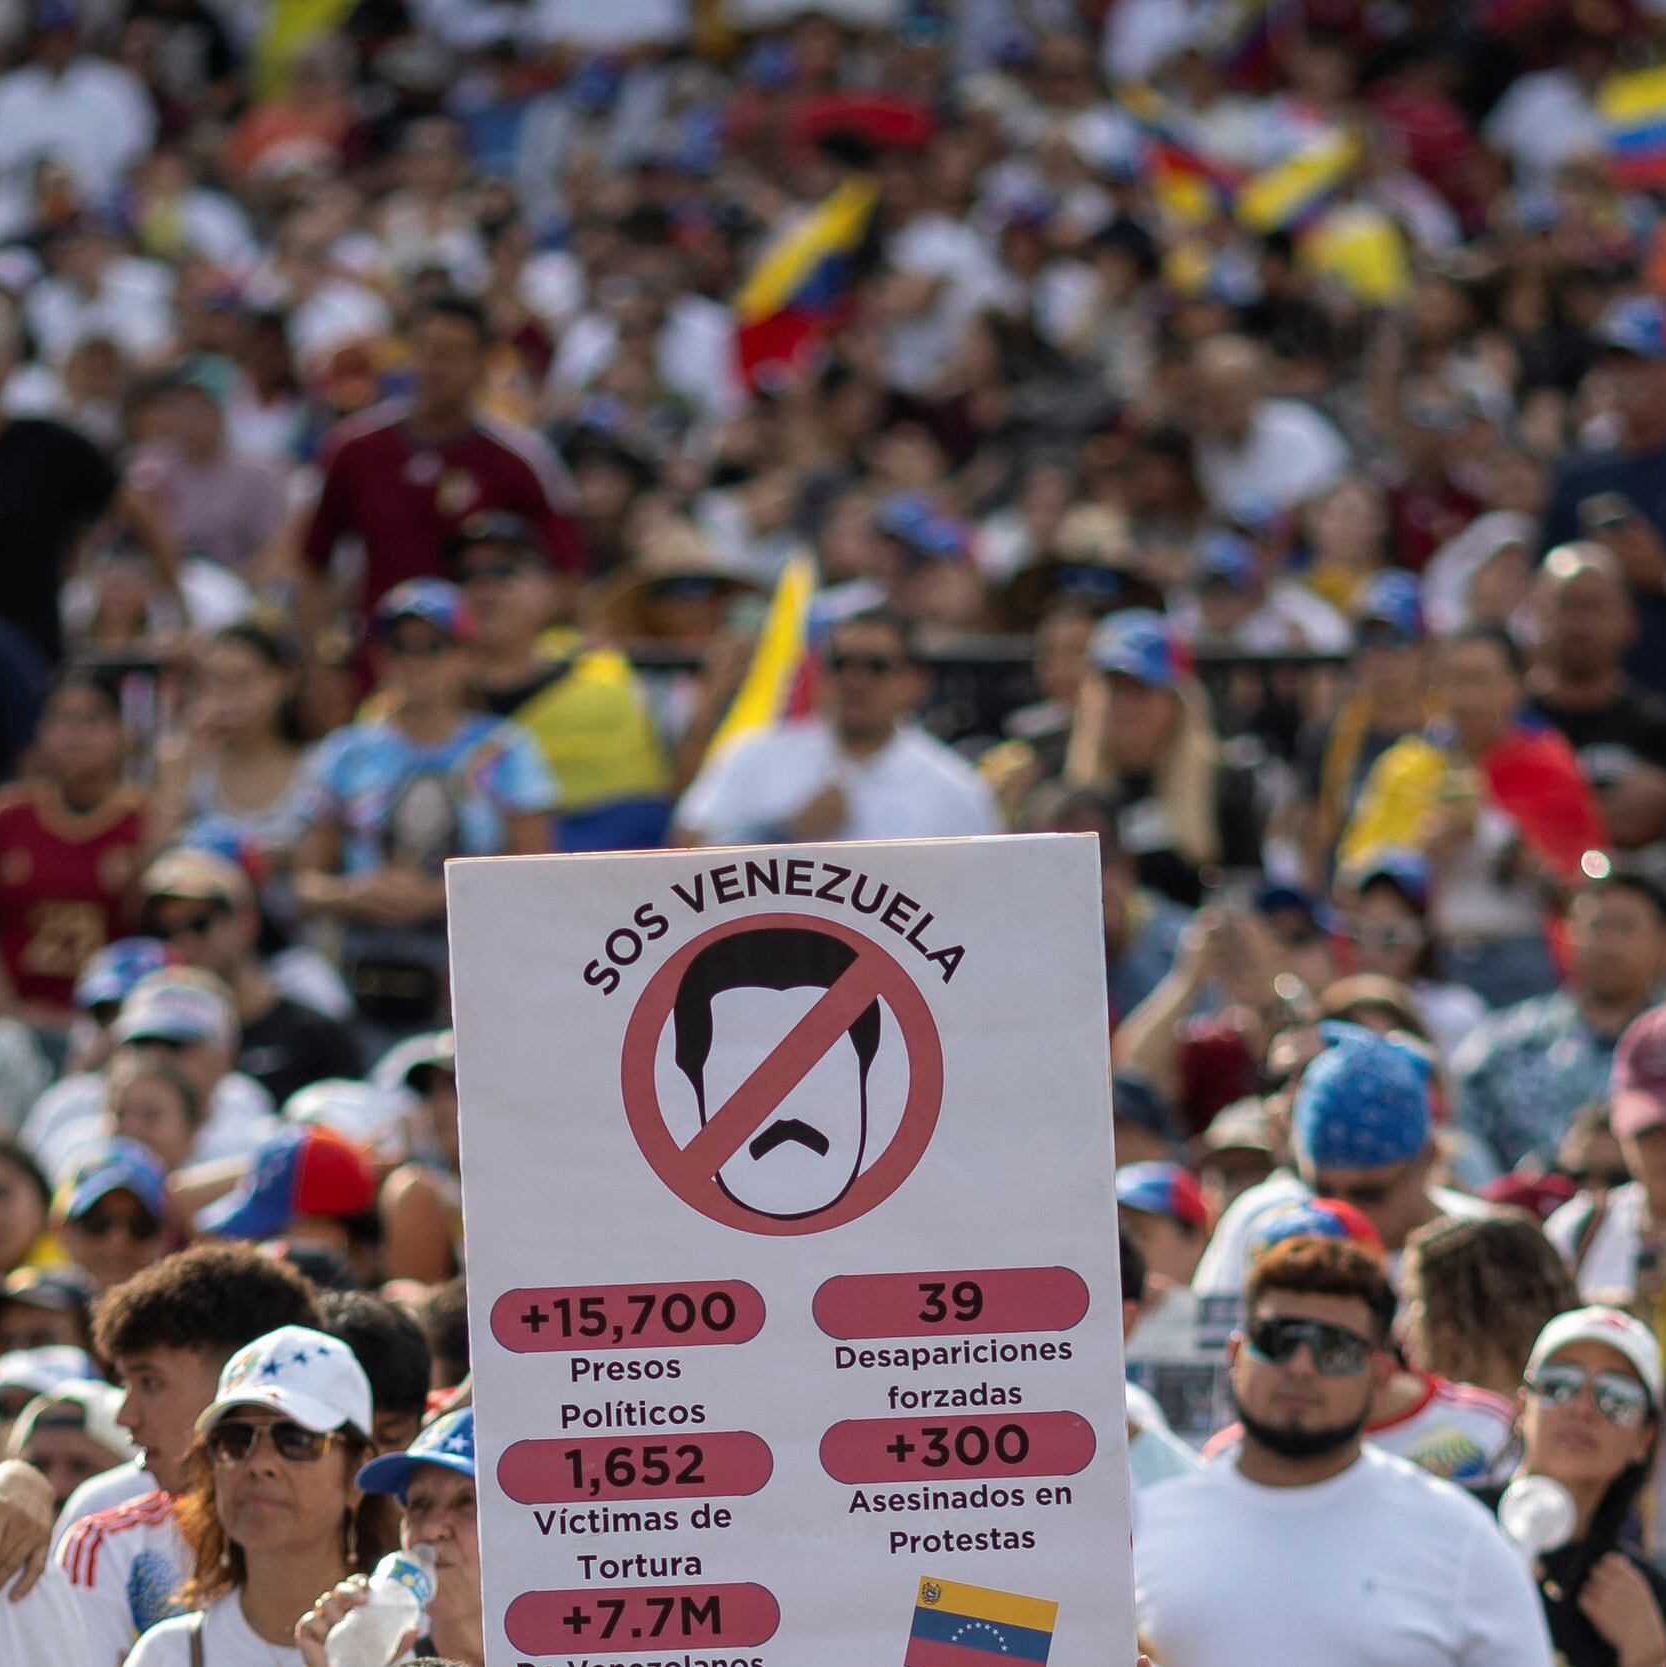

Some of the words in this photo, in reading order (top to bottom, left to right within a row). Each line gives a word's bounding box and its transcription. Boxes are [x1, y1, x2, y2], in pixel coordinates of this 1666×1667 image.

[584, 903, 670, 996] SOS
[671, 859, 966, 984] VENEZUELA
[918, 1280, 984, 1323] 39
[520, 1291, 736, 1345] +15,700
[570, 1357, 681, 1383] Presos
[835, 1340, 1073, 1371] Desapariciones
[887, 1381, 1023, 1410] forzadas
[561, 1400, 706, 1429] Políticos
[886, 1423, 1030, 1468] +300
[564, 1444, 705, 1497] 1,652
[847, 1484, 1026, 1515] Asesinados
[1035, 1486, 1072, 1506] en
[533, 1507, 679, 1536] Víctimas
[690, 1502, 732, 1529] de
[889, 1527, 1036, 1554] Protestas
[576, 1553, 702, 1580] Tortura
[562, 1595, 722, 1640] +7.7M
